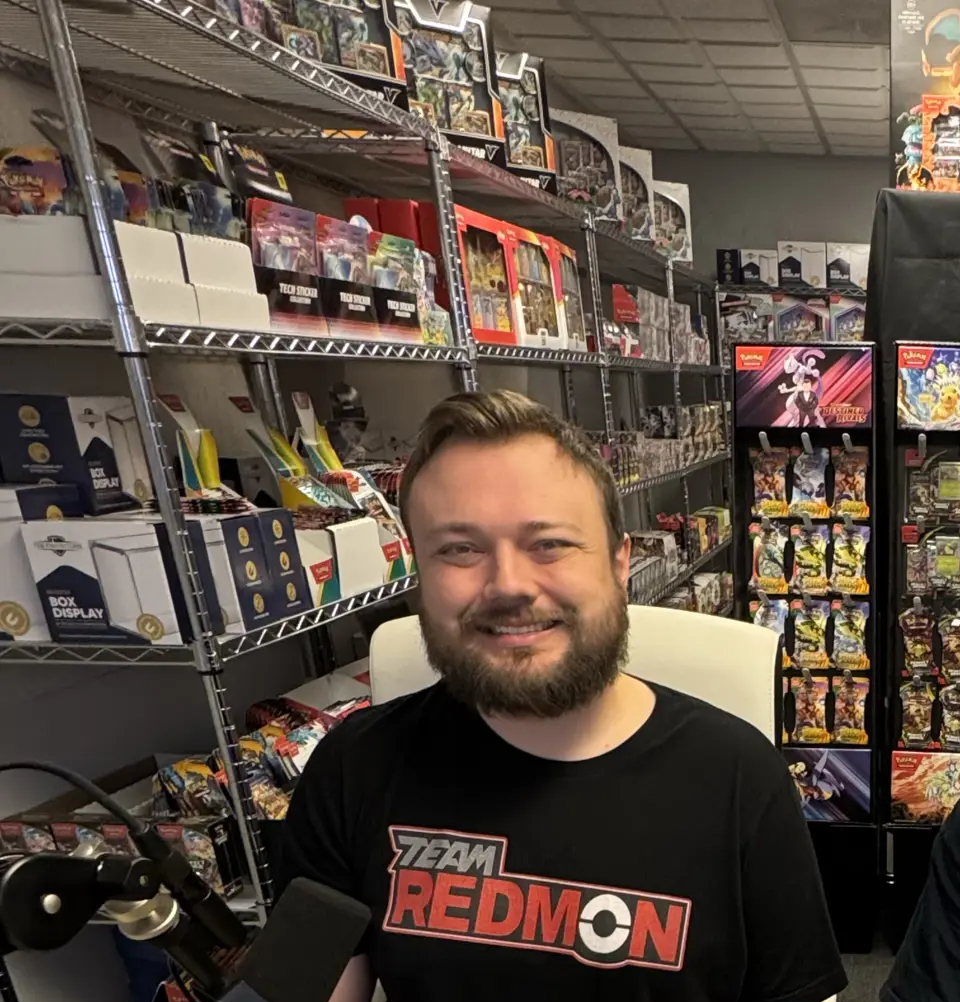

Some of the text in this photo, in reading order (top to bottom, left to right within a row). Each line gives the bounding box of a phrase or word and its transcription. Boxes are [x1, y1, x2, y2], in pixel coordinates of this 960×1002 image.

[89, 466, 105, 479] BOX
[93, 476, 120, 490] DISPLAY
[48, 596, 77, 608] BOX
[52, 606, 104, 620] DISPLAY
[398, 835, 496, 876] TEAM
[392, 869, 683, 962] REDMON
